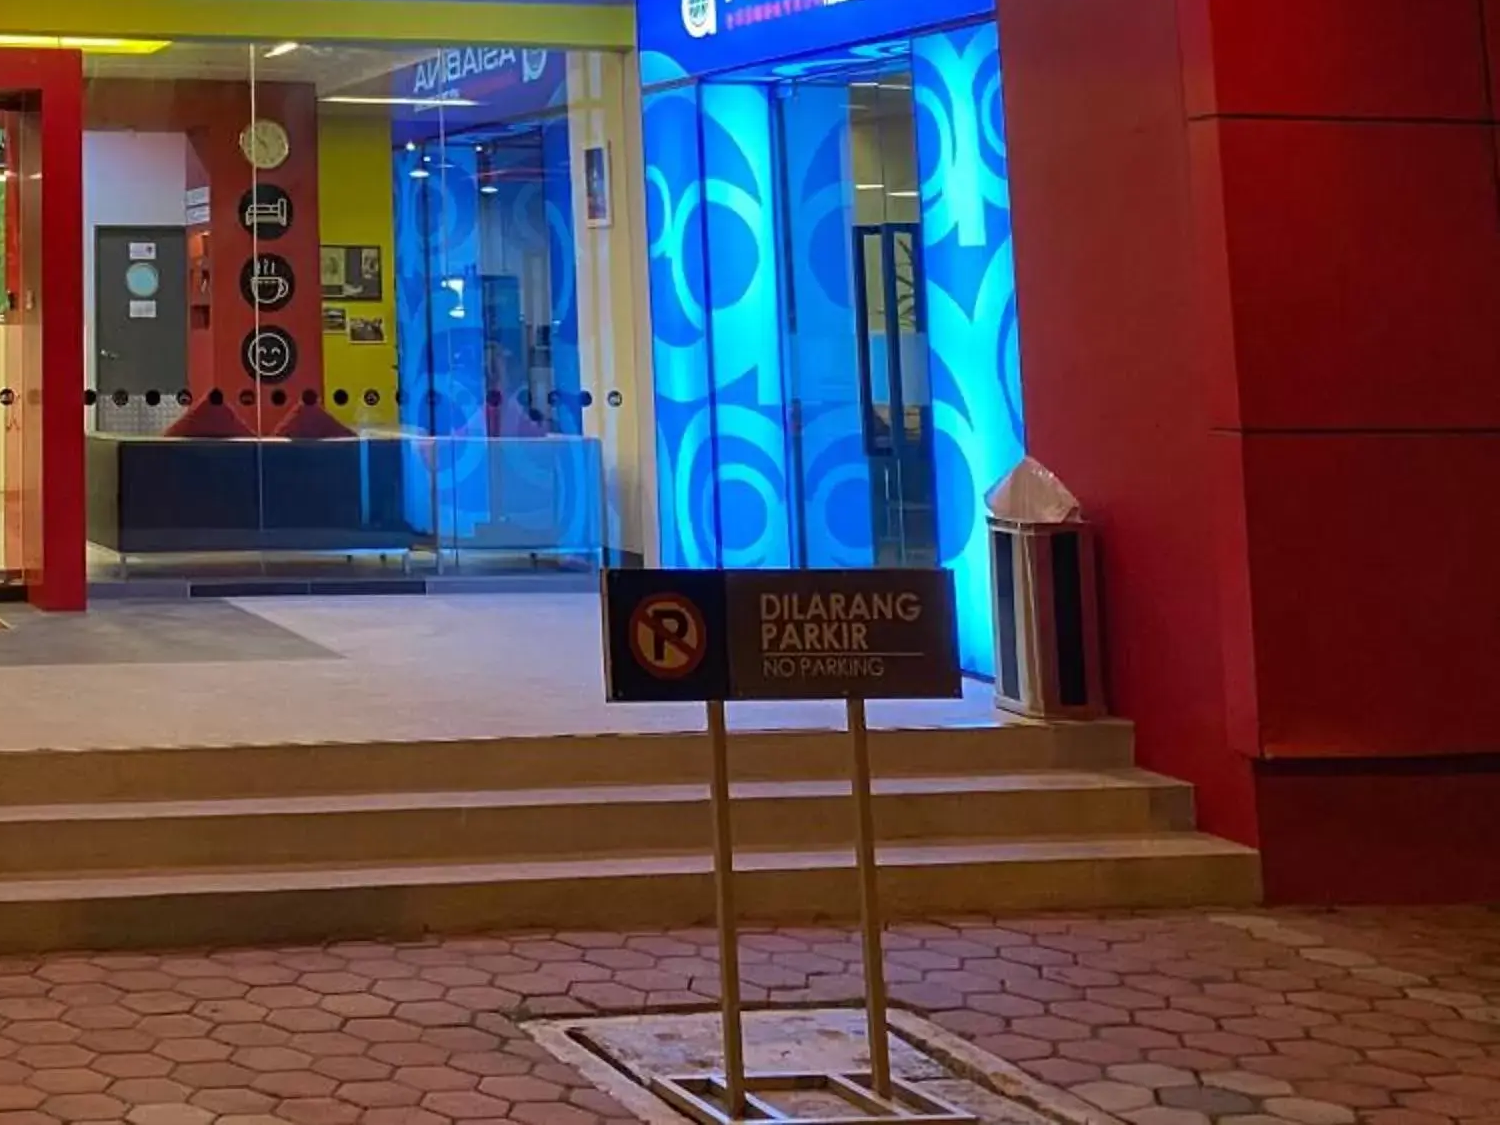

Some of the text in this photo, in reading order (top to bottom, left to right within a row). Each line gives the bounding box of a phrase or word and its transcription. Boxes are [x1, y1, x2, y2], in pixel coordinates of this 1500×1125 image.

[760, 592, 924, 622] DILARANG
[760, 623, 870, 651] PARKIR
[763, 657, 886, 677] NO PARKING
